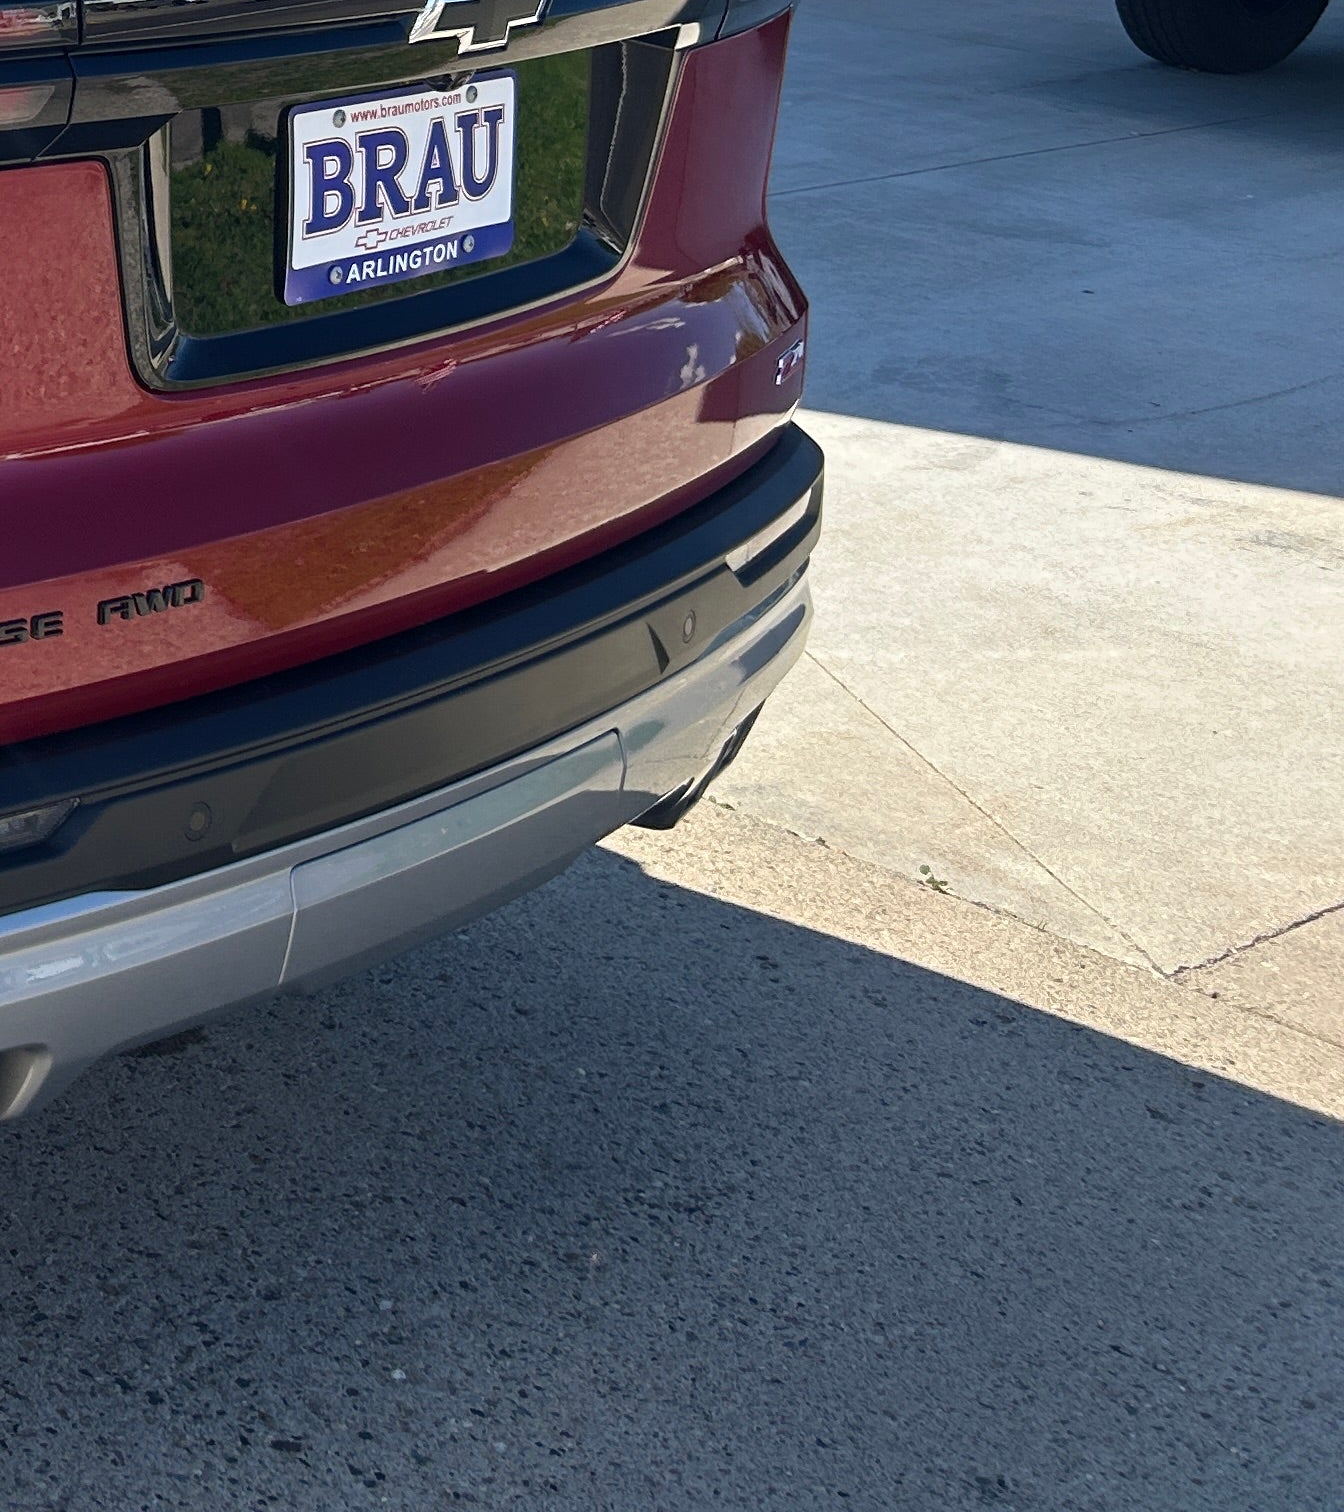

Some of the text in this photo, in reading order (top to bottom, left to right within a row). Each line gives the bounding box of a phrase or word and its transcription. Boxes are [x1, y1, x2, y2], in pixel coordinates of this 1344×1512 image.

[350, 92, 462, 123] www.braumotors.com
[302, 104, 505, 239] BRAU
[388, 215, 454, 241] CHEVROLET
[345, 239, 458, 284] ARLINGTON
[97, 578, 205, 625] AWD
